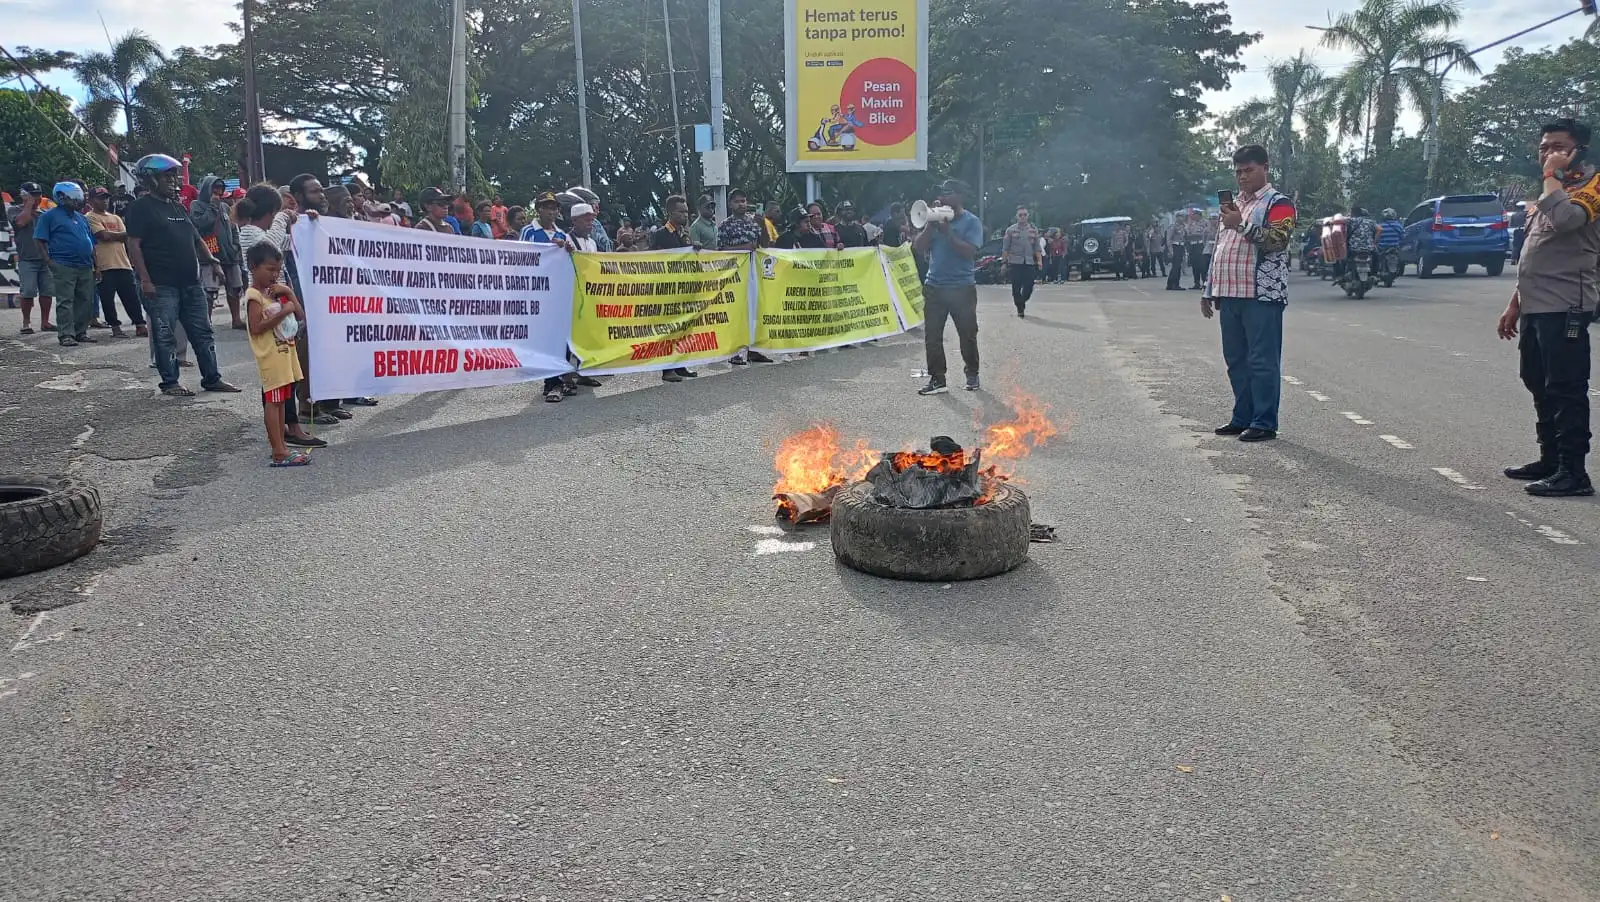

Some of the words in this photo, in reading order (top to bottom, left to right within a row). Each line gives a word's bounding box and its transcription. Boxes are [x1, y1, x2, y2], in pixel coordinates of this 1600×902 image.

[805, 9, 855, 22] Hemat
[860, 9, 898, 21] terus
[805, 27, 847, 41] tanpa
[852, 24, 905, 41] promo!
[864, 81, 900, 92] Pesan
[861, 96, 904, 108] Maxim
[869, 112, 896, 124] Bike
[328, 236, 355, 256] KAMI
[357, 239, 422, 261] MASYARAKAT
[425, 245, 478, 265] SIMPATISAN
[478, 249, 496, 265] DAN
[497, 250, 541, 267] PENDUKUNG
[620, 261, 665, 275] MASYARAKAT
[312, 265, 353, 285] PARTAI
[356, 268, 404, 288] GOLONGAN
[406, 271, 436, 289] KARYA
[438, 272, 476, 290] PROVINSI
[477, 274, 504, 291] PAPUA
[505, 275, 530, 291] BARAT
[531, 276, 550, 292] DAYA
[586, 281, 615, 297] PARTAI
[617, 282, 655, 297] GOLONGAN
[656, 281, 676, 297] KARYA
[328, 295, 384, 314] MENOLAK
[386, 297, 421, 315] DENGAN
[421, 298, 447, 315] TEGAS
[449, 299, 502, 316] PENYERAHAN
[503, 300, 529, 316] MODEL
[530, 300, 540, 316] BB
[596, 303, 633, 319] MENOLAK
[634, 303, 662, 318] DENGAN
[663, 303, 681, 317] TEGAS
[725, 291, 735, 304] BB
[346, 324, 417, 343] PENCALONAN
[419, 324, 451, 341] KEPALA
[480, 325, 499, 341] KWK
[499, 324, 528, 340] KEPADA
[608, 323, 655, 341] PENCALONAN
[704, 311, 729, 326] KEPADA
[676, 331, 719, 355] SAGRIM
[373, 348, 459, 378] BERNARD
[463, 347, 521, 372] SAGRIM
